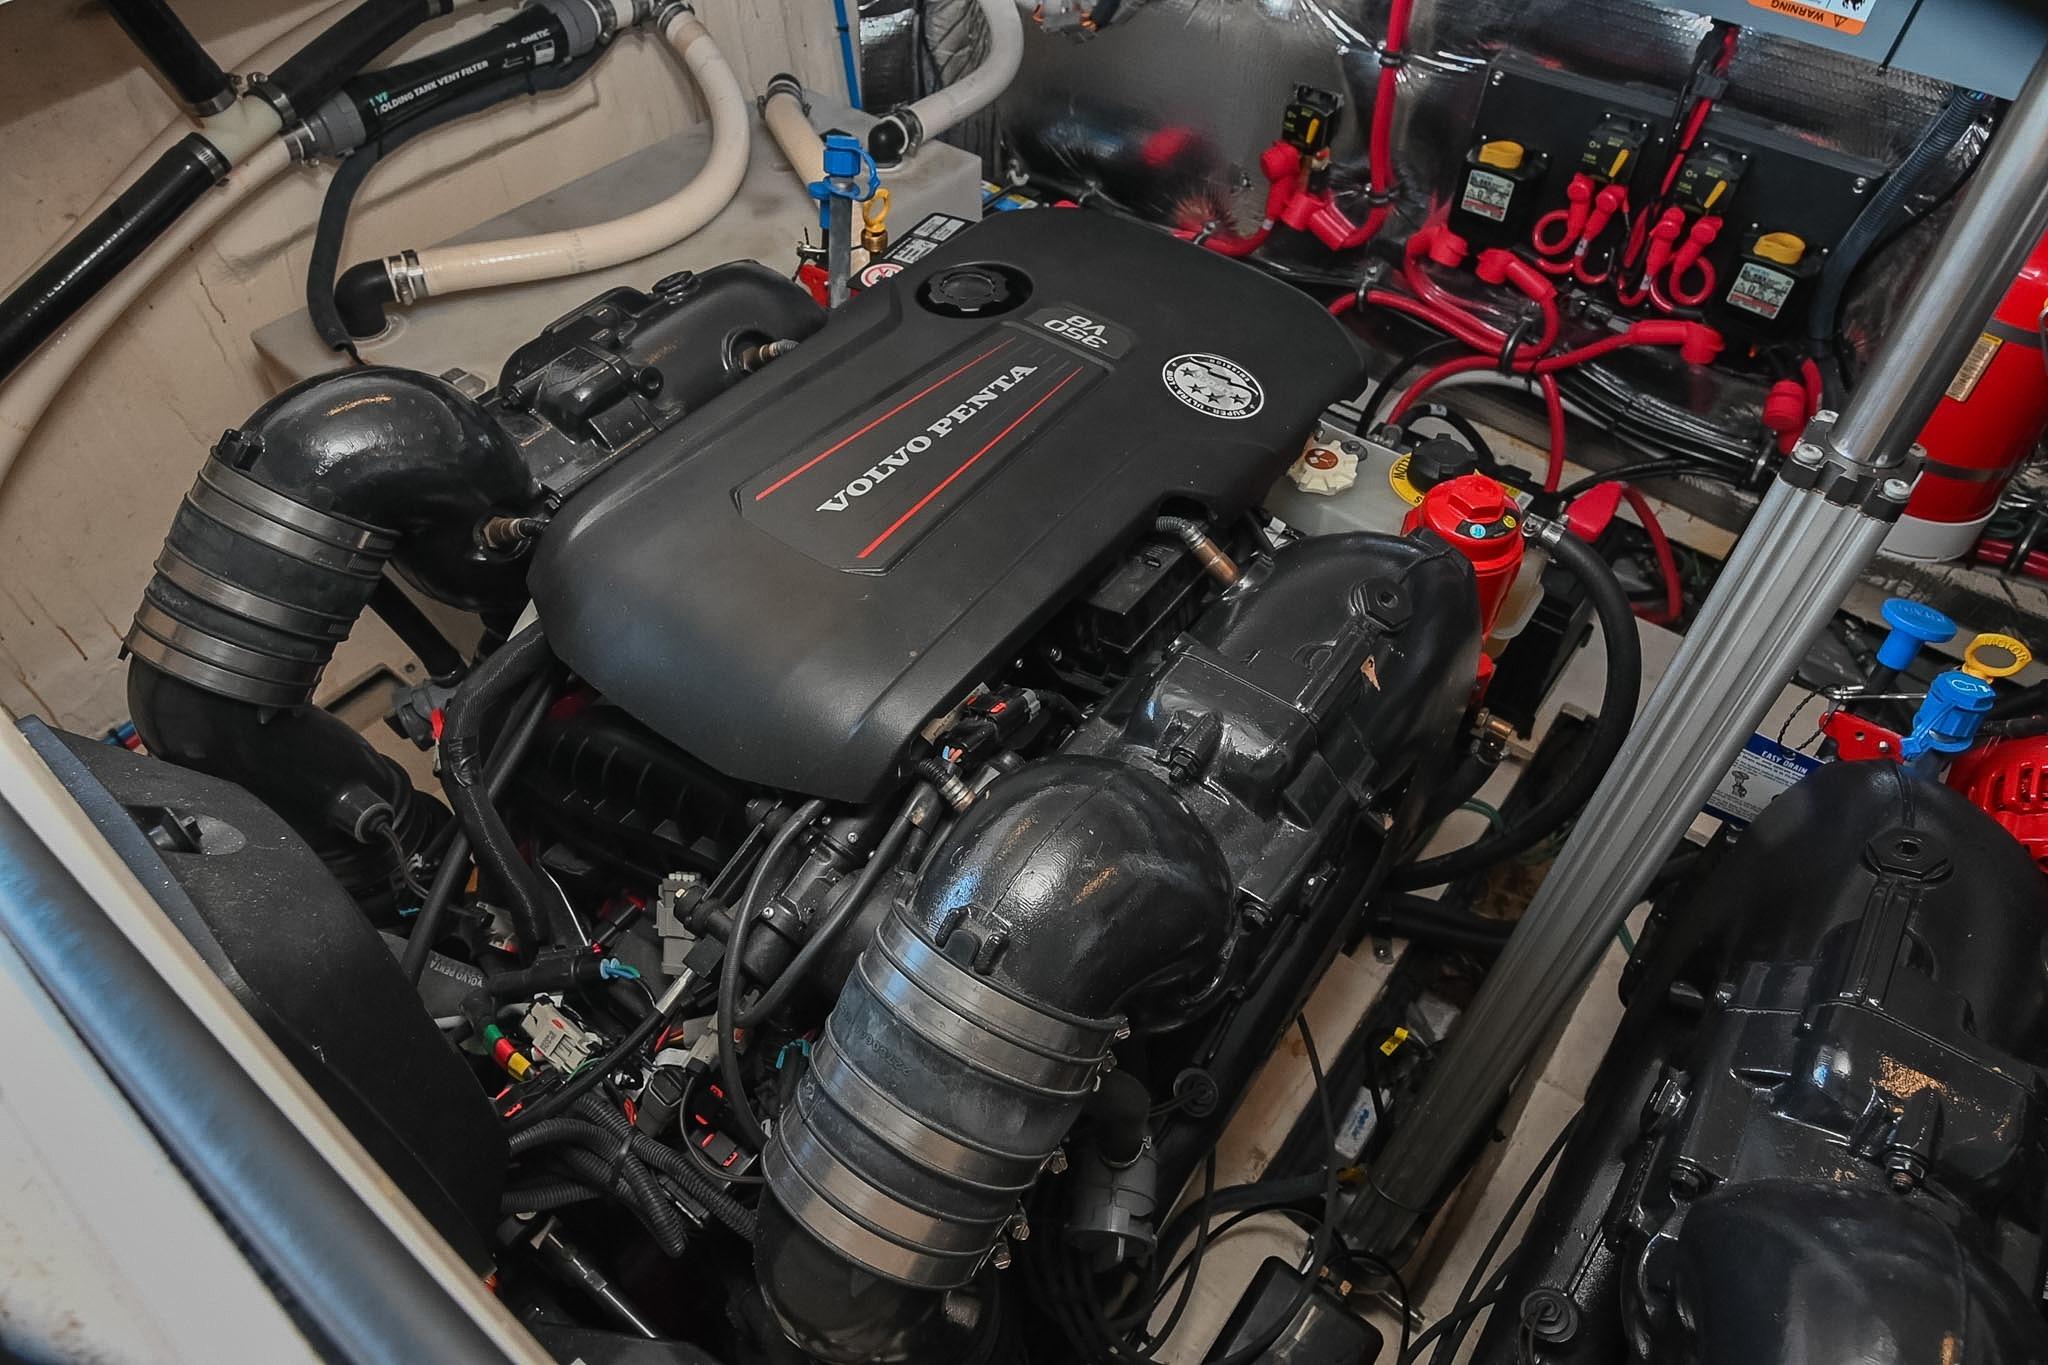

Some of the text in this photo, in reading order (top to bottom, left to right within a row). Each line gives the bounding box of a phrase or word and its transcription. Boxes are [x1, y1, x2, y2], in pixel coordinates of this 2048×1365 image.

[1770, 0, 1825, 22] WARNING
[413, 80, 438, 97] TANK
[436, 71, 460, 86] VENT
[460, 60, 489, 78] FILTER
[1044, 319, 1108, 348] 350
[1065, 315, 1106, 336] V8
[1176, 389, 1205, 410] ULTRA
[1212, 408, 1247, 417] SUPER
[816, 365, 1038, 512] VOLVO PENTA
[1393, 456, 1411, 480] LLOW
[1984, 639, 2028, 662] MOTOR
[1761, 750, 1809, 775] EASY DRAIN
[429, 959, 483, 988] VOLVO PENTA
